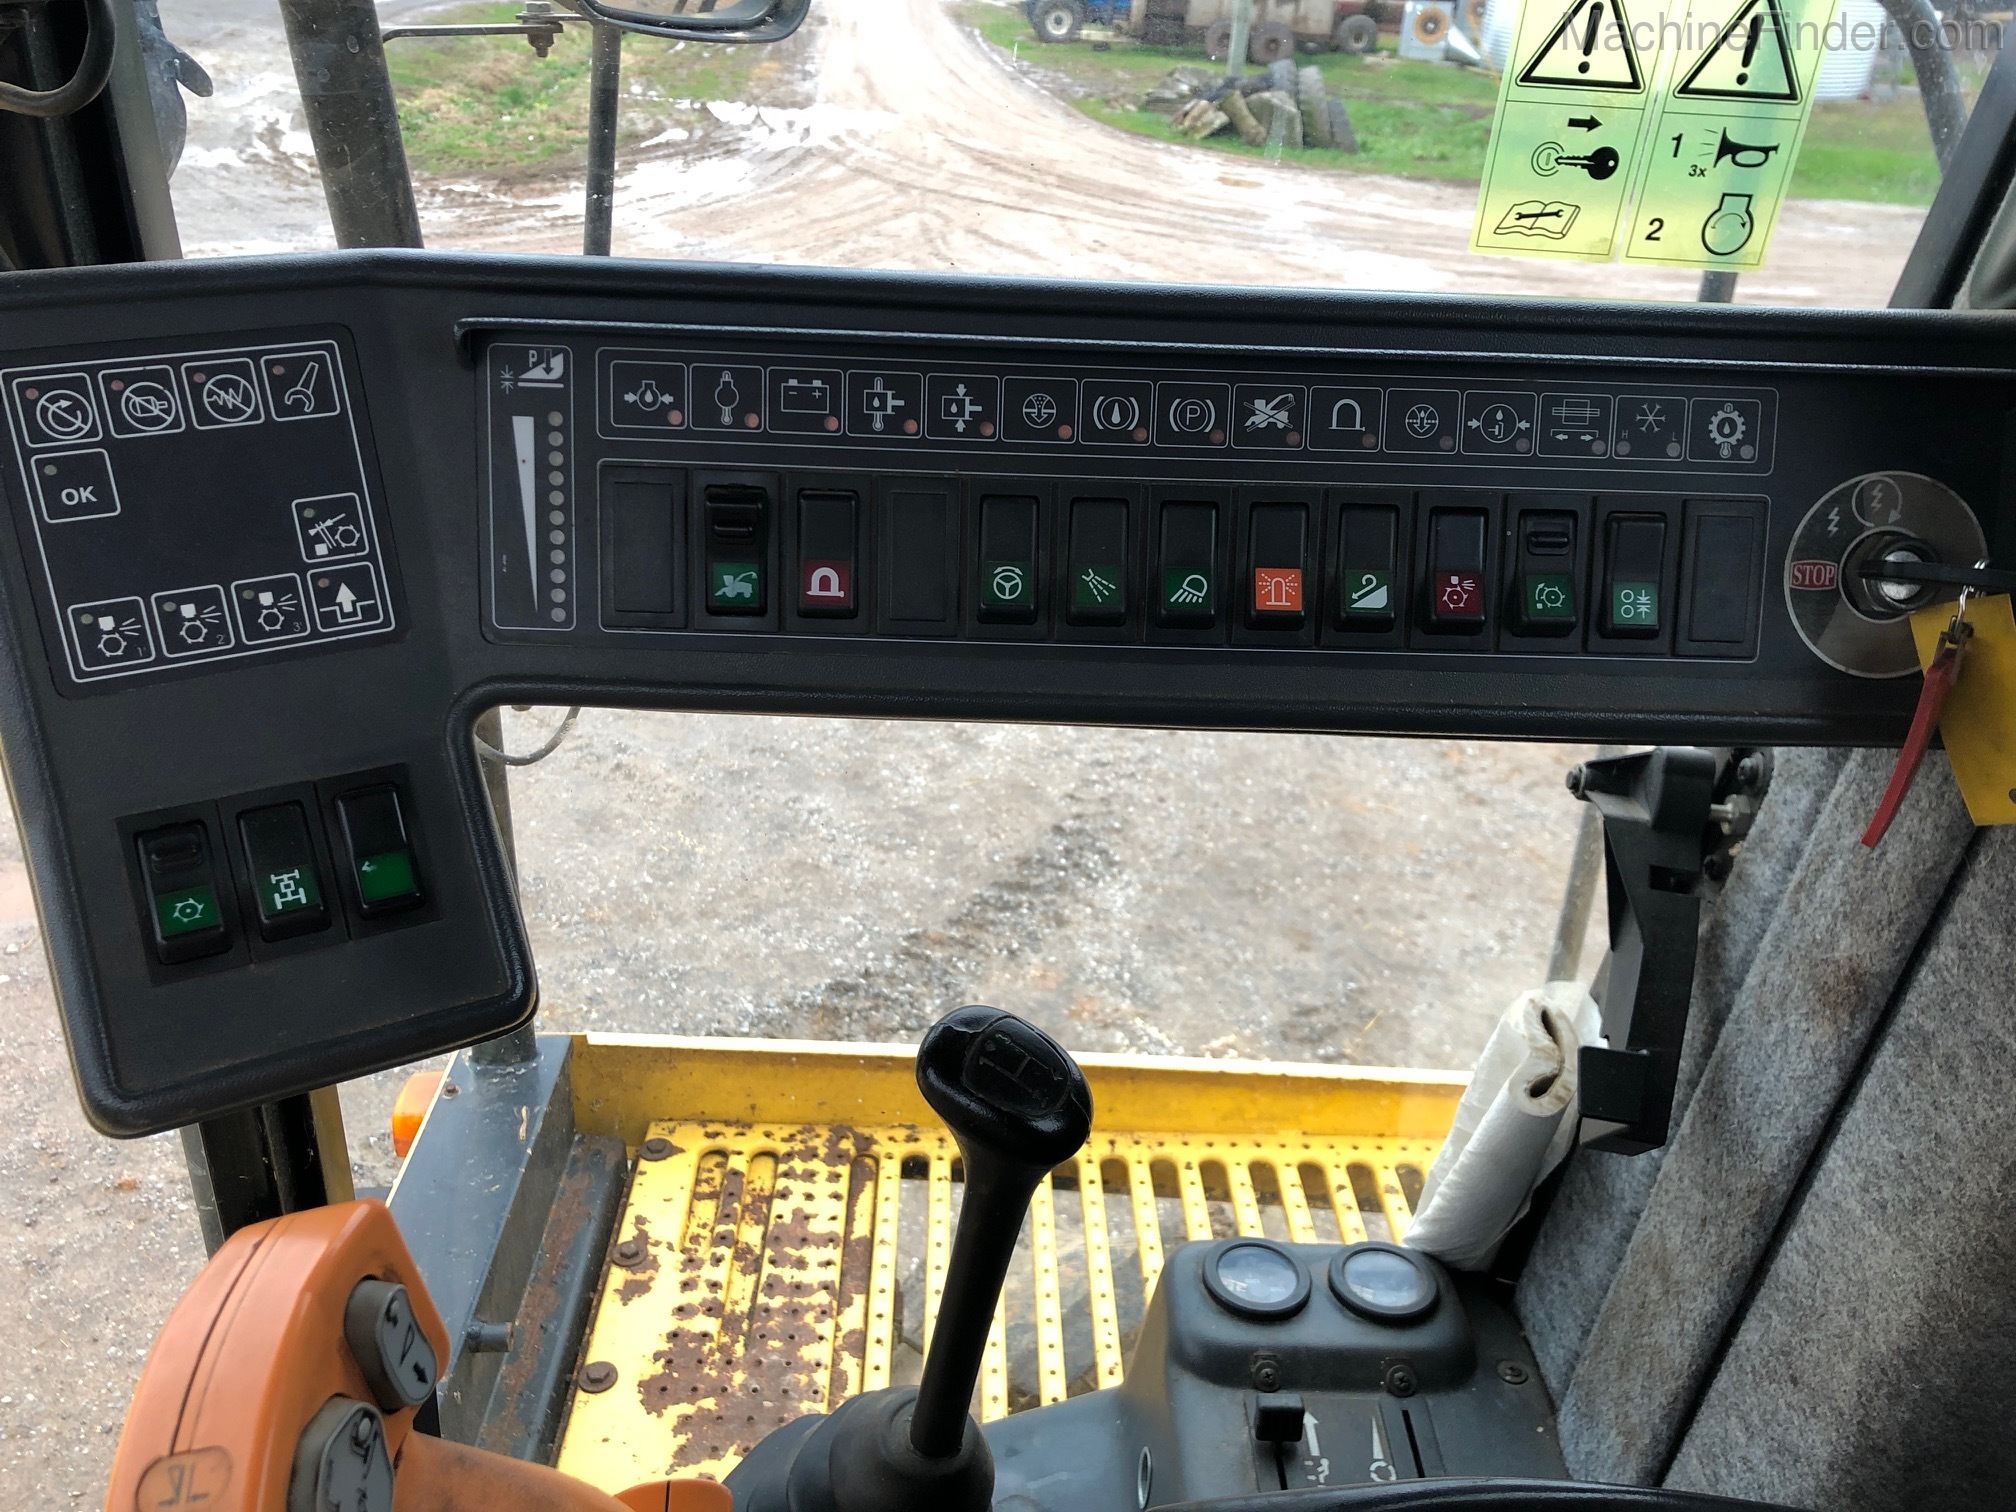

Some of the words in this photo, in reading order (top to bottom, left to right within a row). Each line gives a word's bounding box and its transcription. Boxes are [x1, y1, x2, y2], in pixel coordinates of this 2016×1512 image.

[1671, 132, 1684, 158] 1
[1688, 164, 1707, 178] 3x
[1645, 217, 1664, 241] 2
[528, 349, 538, 368] P
[1186, 405, 1201, 426] P
[1621, 430, 1629, 439] H
[1672, 431, 1678, 441] L
[61, 485, 98, 506] OK
[1792, 564, 1836, 586] STOP
[215, 634, 225, 645] 2
